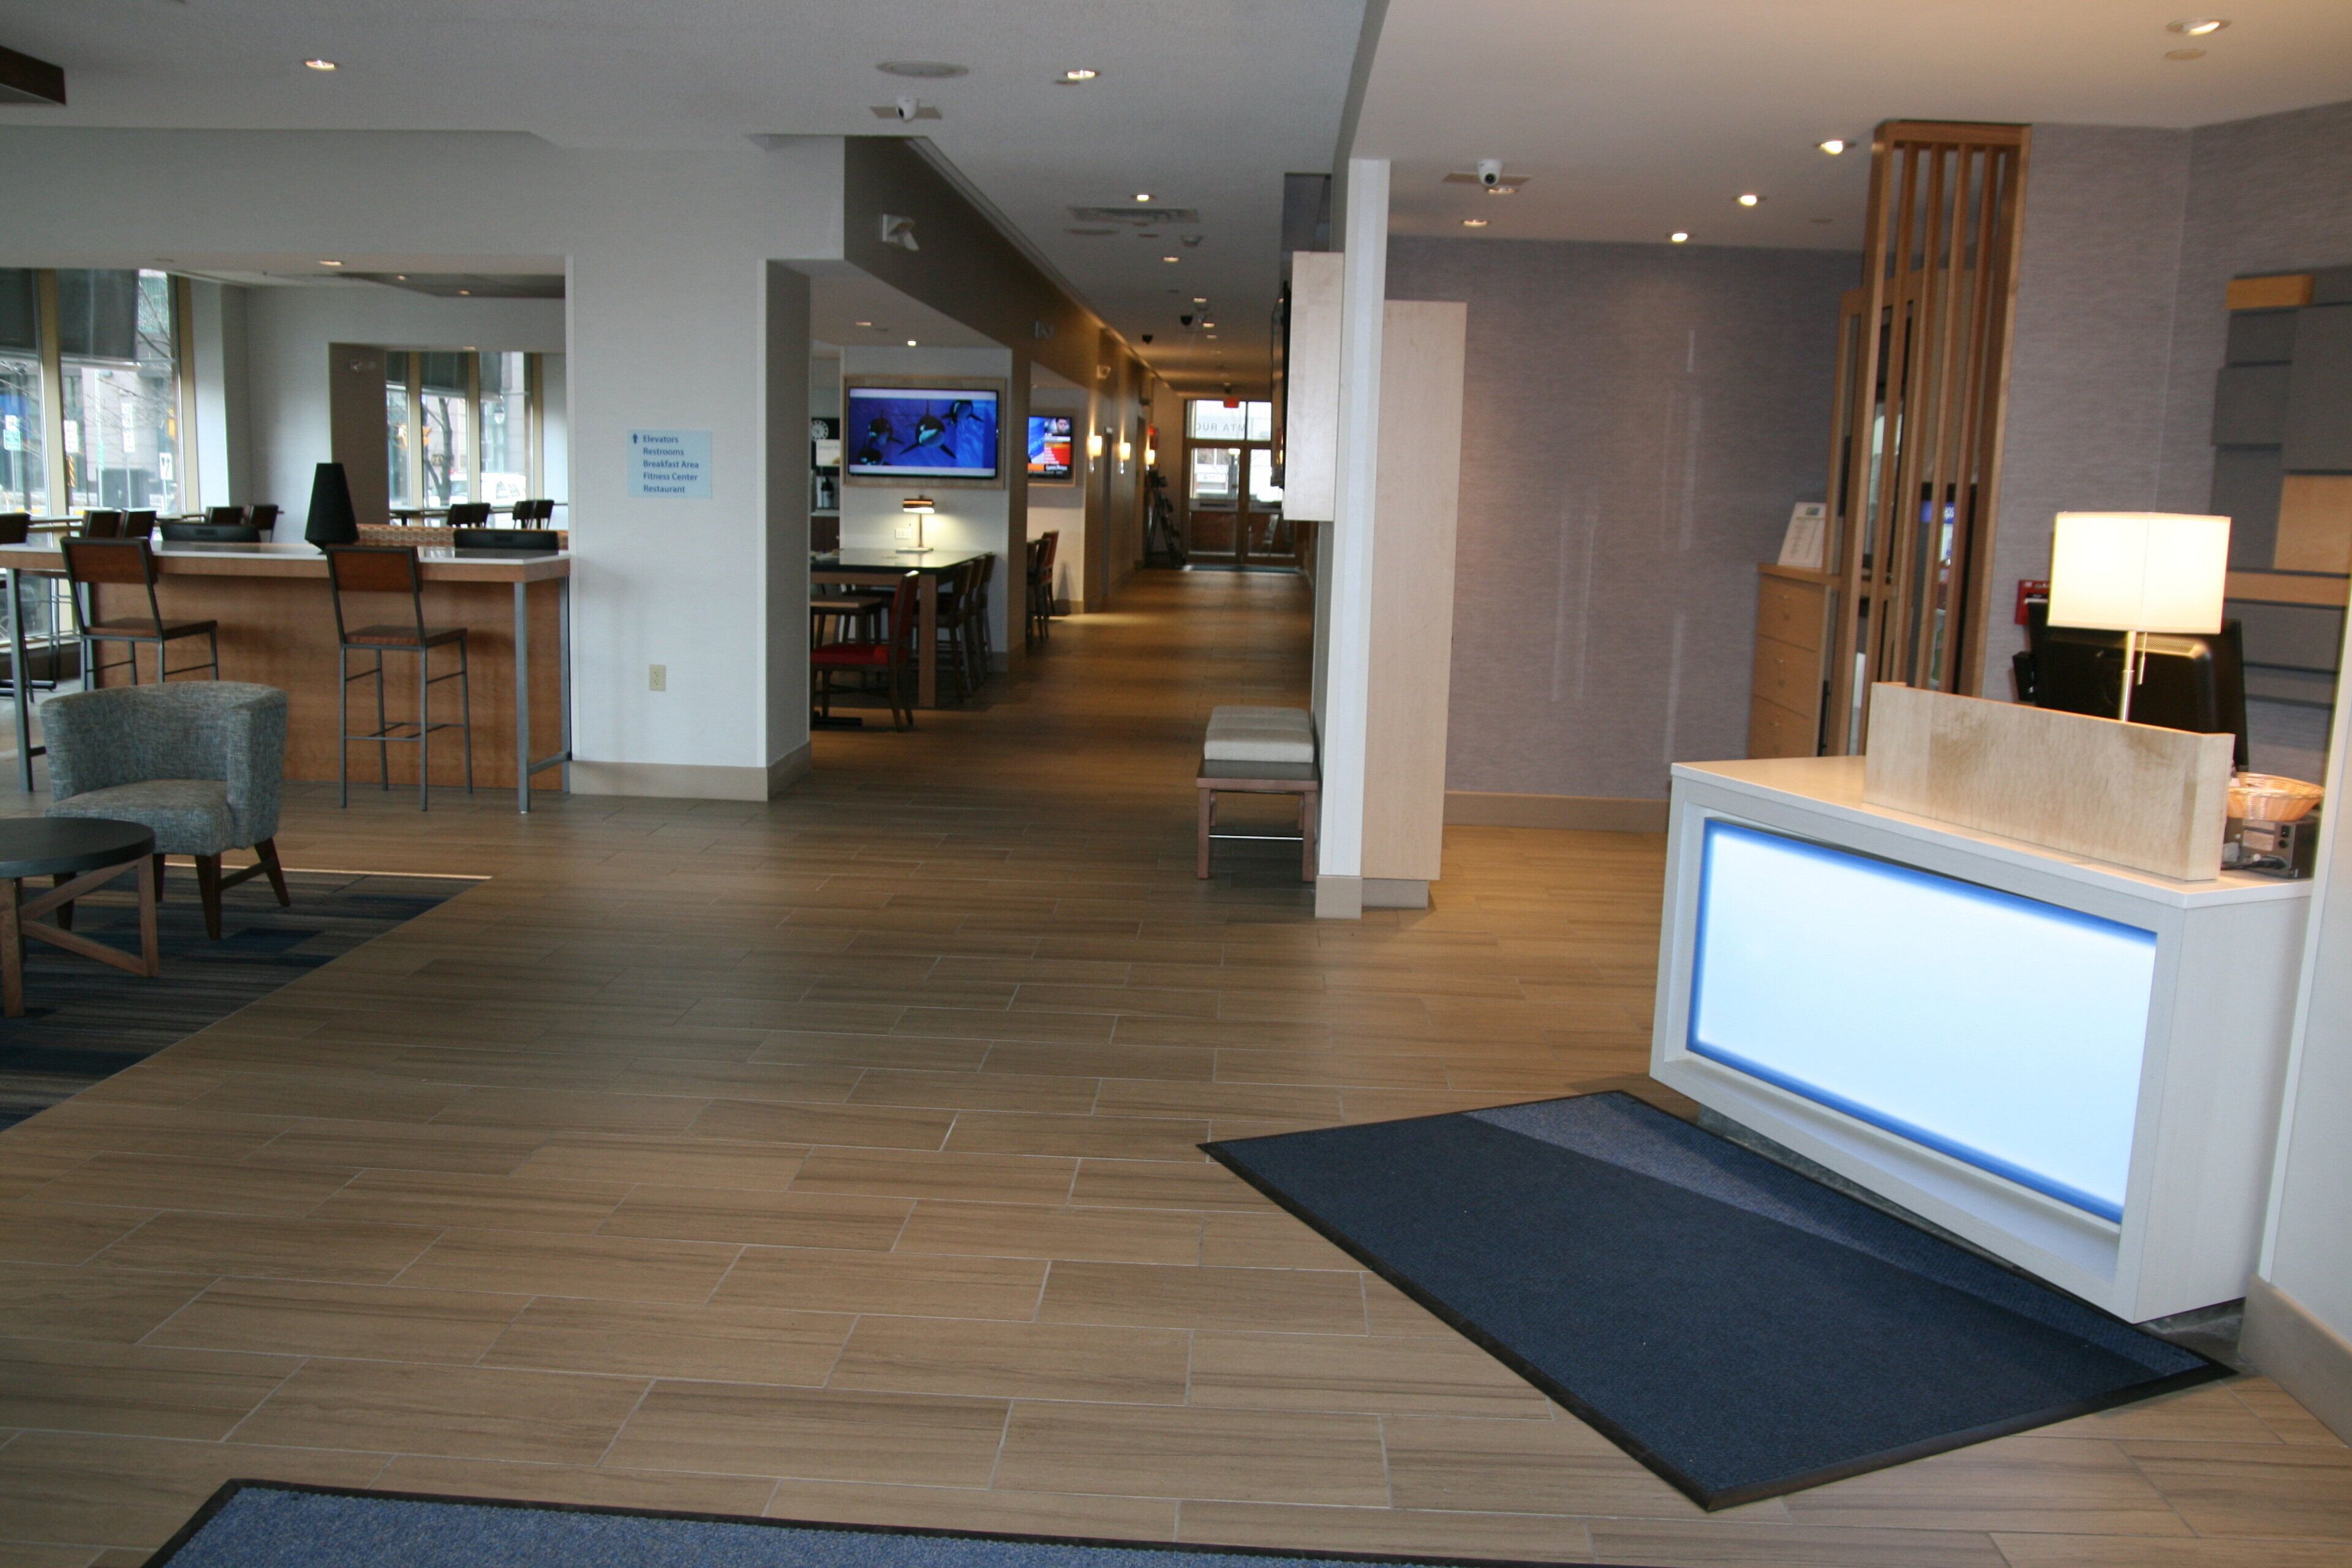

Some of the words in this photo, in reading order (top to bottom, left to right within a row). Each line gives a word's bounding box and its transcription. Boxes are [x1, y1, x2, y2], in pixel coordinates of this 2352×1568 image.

[643, 435, 679, 443] Elevators
[643, 460, 679, 469] Breakfast
[643, 484, 685, 493] Restaurant
